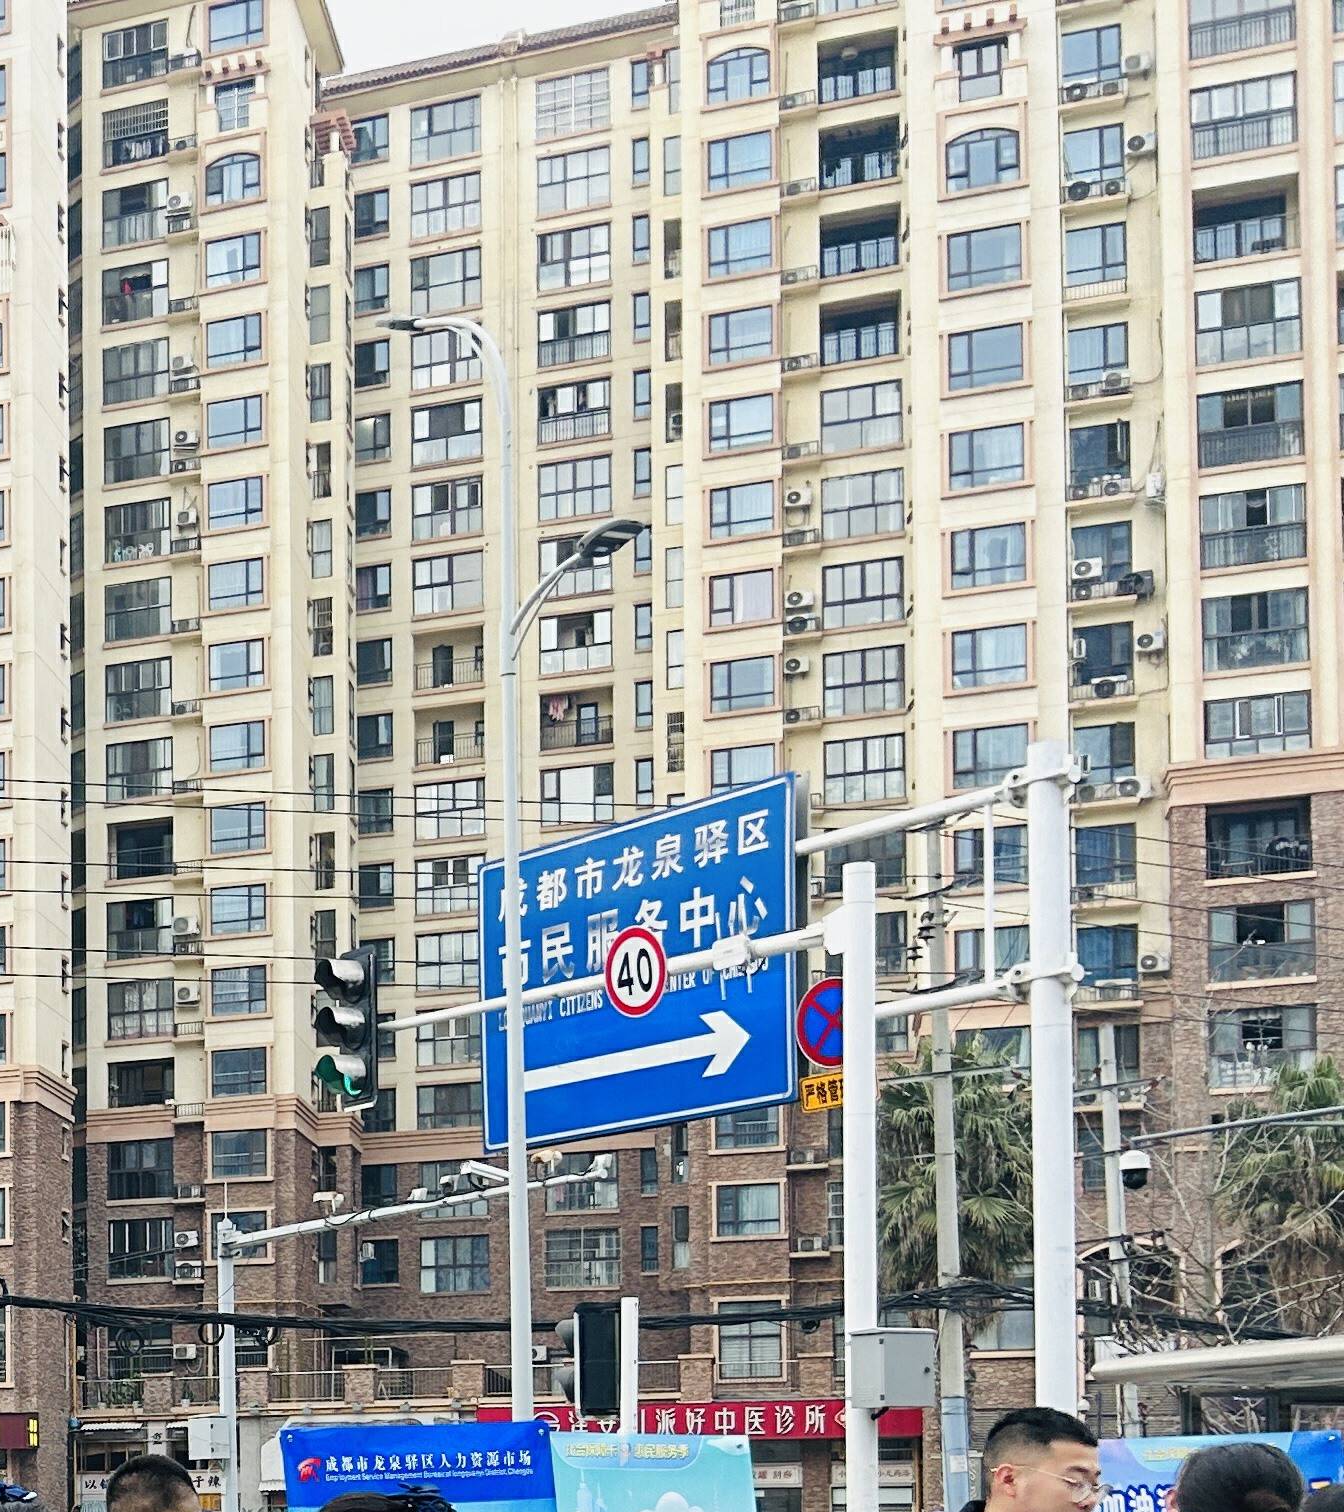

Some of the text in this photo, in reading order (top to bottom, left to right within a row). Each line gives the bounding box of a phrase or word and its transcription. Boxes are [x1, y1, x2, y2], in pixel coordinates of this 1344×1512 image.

[618, 949, 653, 995] 40
[559, 992, 603, 1016] CITIZENS
[326, 1450, 532, 1473] 成都市龙泉驿区人力资源市场
